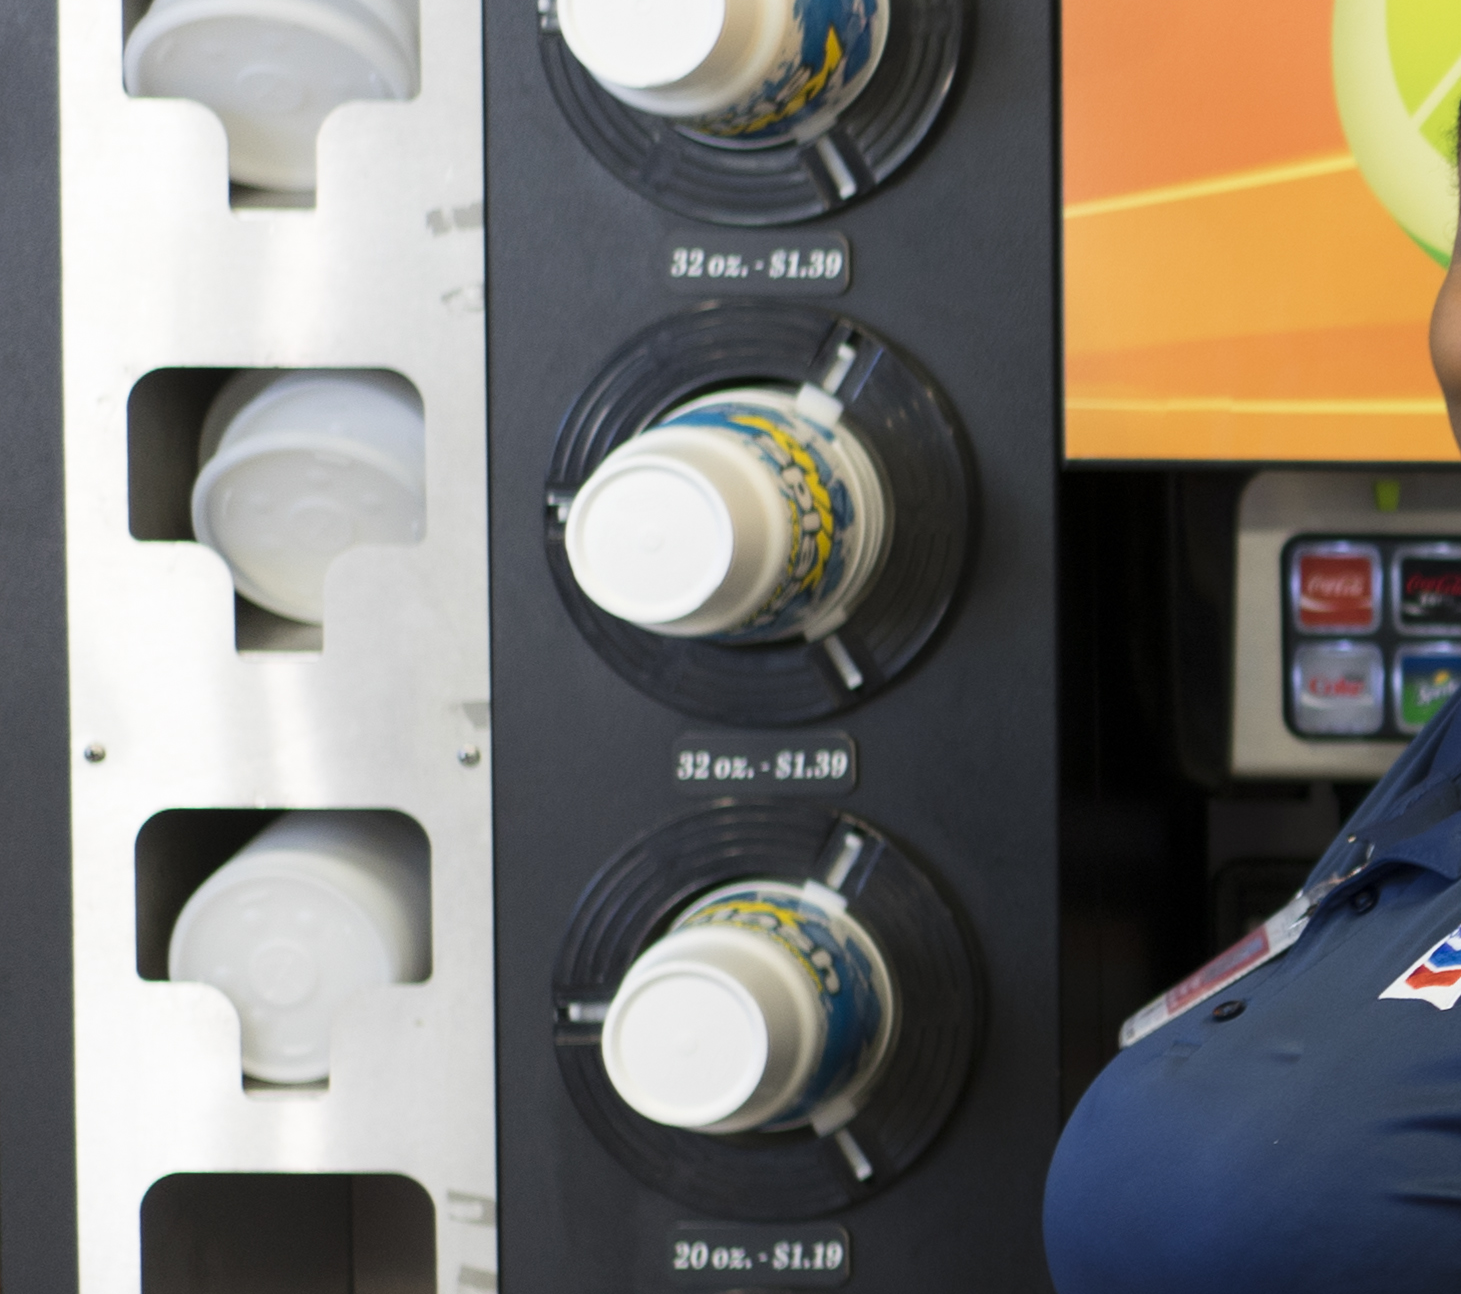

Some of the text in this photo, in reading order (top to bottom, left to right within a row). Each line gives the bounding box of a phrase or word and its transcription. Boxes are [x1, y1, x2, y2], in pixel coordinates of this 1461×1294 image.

[670, 248, 705, 278] 32
[706, 253, 749, 278] oz.
[769, 247, 844, 280] $1.39
[676, 750, 711, 781] 32
[712, 756, 754, 781] oz.
[775, 748, 849, 783] $1.39
[672, 1240, 708, 1271] 20
[710, 1246, 753, 1271] oz.
[772, 1239, 845, 1273] $1.19
